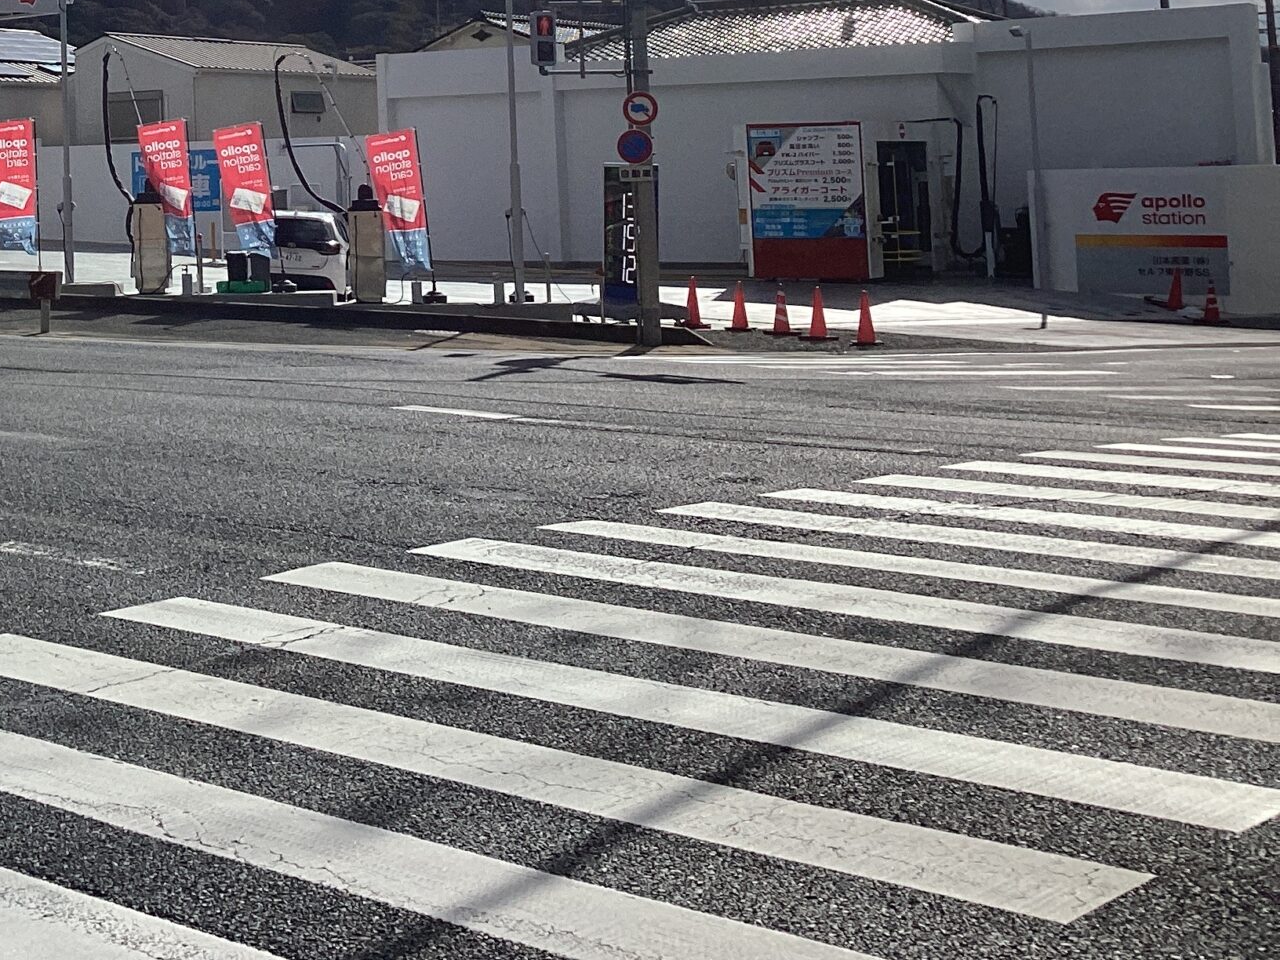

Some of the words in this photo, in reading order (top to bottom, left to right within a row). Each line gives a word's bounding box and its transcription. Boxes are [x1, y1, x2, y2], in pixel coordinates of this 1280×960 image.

[1141, 194, 1205, 211] apollo
[1142, 211, 1206, 225] station
[622, 224, 636, 252] 15
[622, 255, 637, 283] 12
